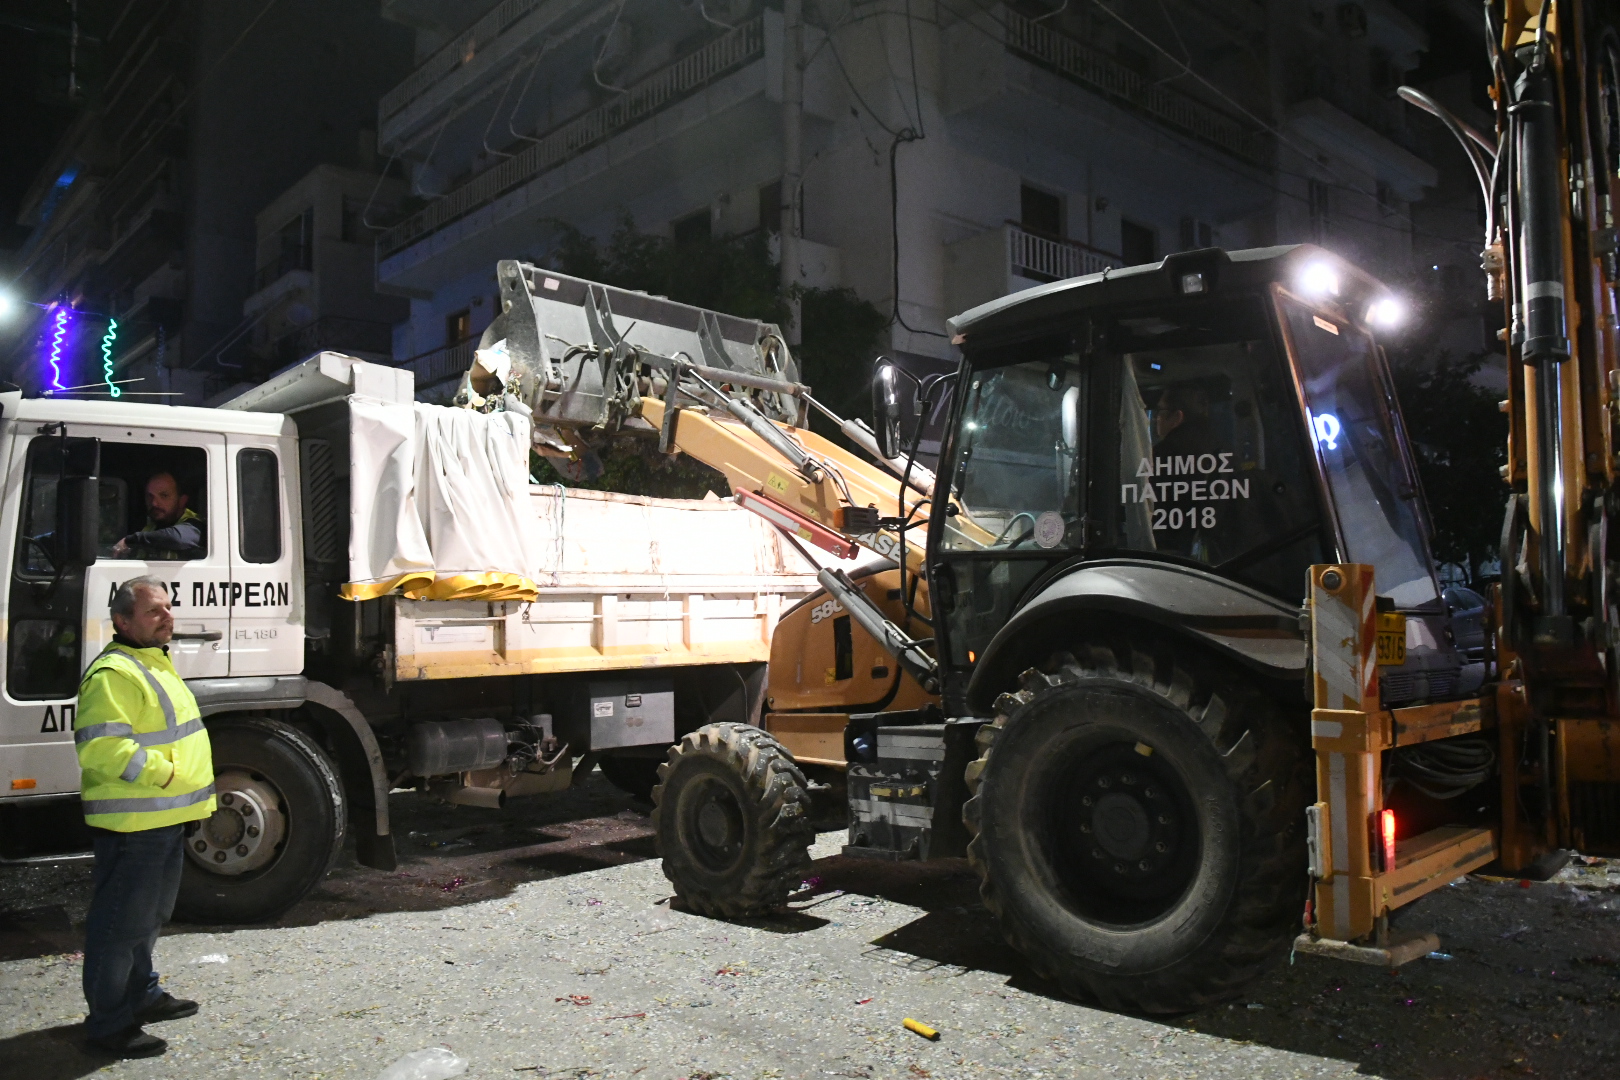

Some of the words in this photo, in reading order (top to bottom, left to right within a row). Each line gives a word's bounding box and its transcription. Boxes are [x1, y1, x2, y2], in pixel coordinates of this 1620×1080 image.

[1135, 452, 1234, 477] ΔΗΜΟΣ
[1121, 478, 1250, 504] ΠΑΤΡΕΩΝ
[1152, 506, 1217, 530] 2018
[849, 532, 910, 563] ASE
[192, 581, 289, 607] ΠΑΤΡΕΩΝ
